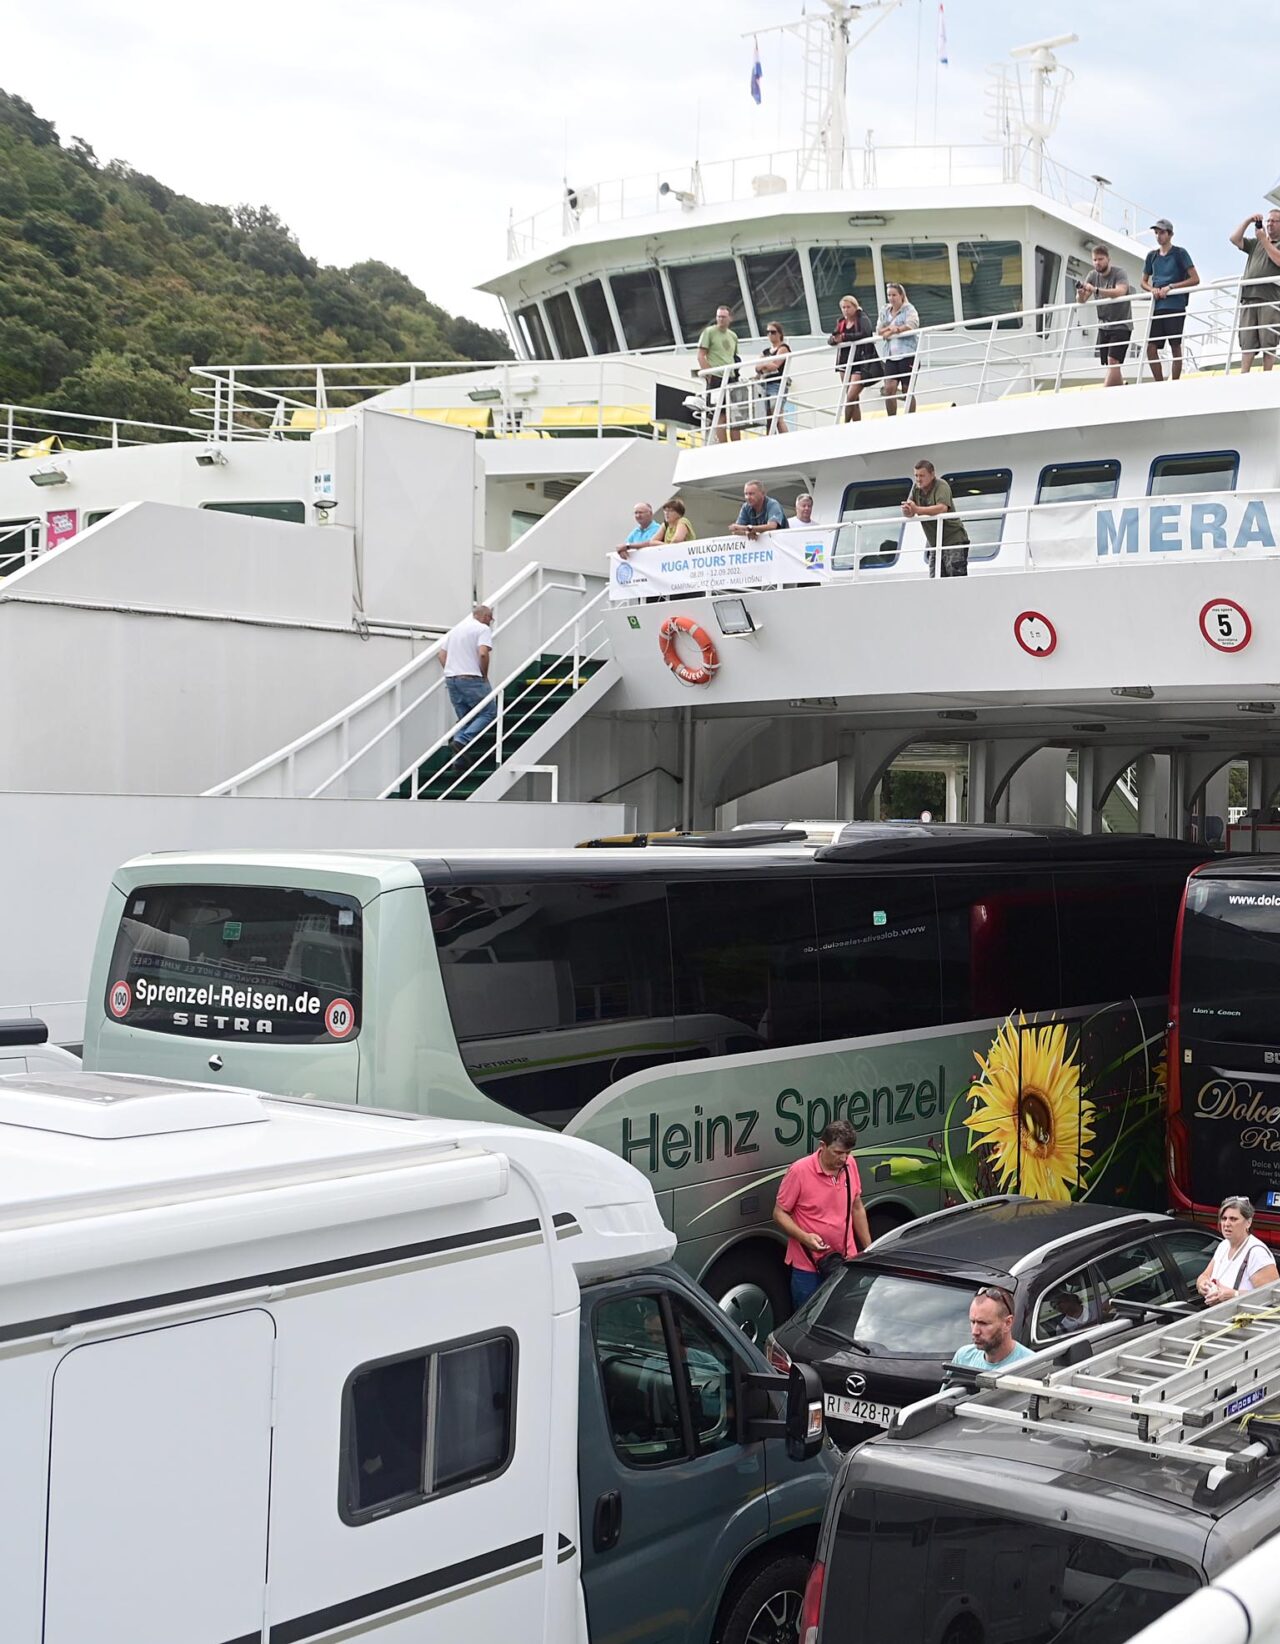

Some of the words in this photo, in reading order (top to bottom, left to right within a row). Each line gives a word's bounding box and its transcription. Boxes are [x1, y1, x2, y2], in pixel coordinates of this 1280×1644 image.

[687, 541, 746, 556] WILLKOMMEN
[661, 559, 689, 573] KUGA
[691, 554, 726, 569] TOURS
[729, 550, 774, 565] TREFFEN
[1217, 613, 1232, 637] 5
[680, 668, 705, 681] RIJEKA
[114, 992, 127, 1006] 100
[135, 978, 321, 1014] Sprenzel-Reisen.de
[173, 1012, 273, 1033] SETRA
[332, 1010, 347, 1026] 80
[621, 1104, 760, 1173] Heinz
[774, 1064, 946, 1153] Sprenzel
[1251, 1159, 1272, 1169] Dolce
[827, 1395, 841, 1413] RI
